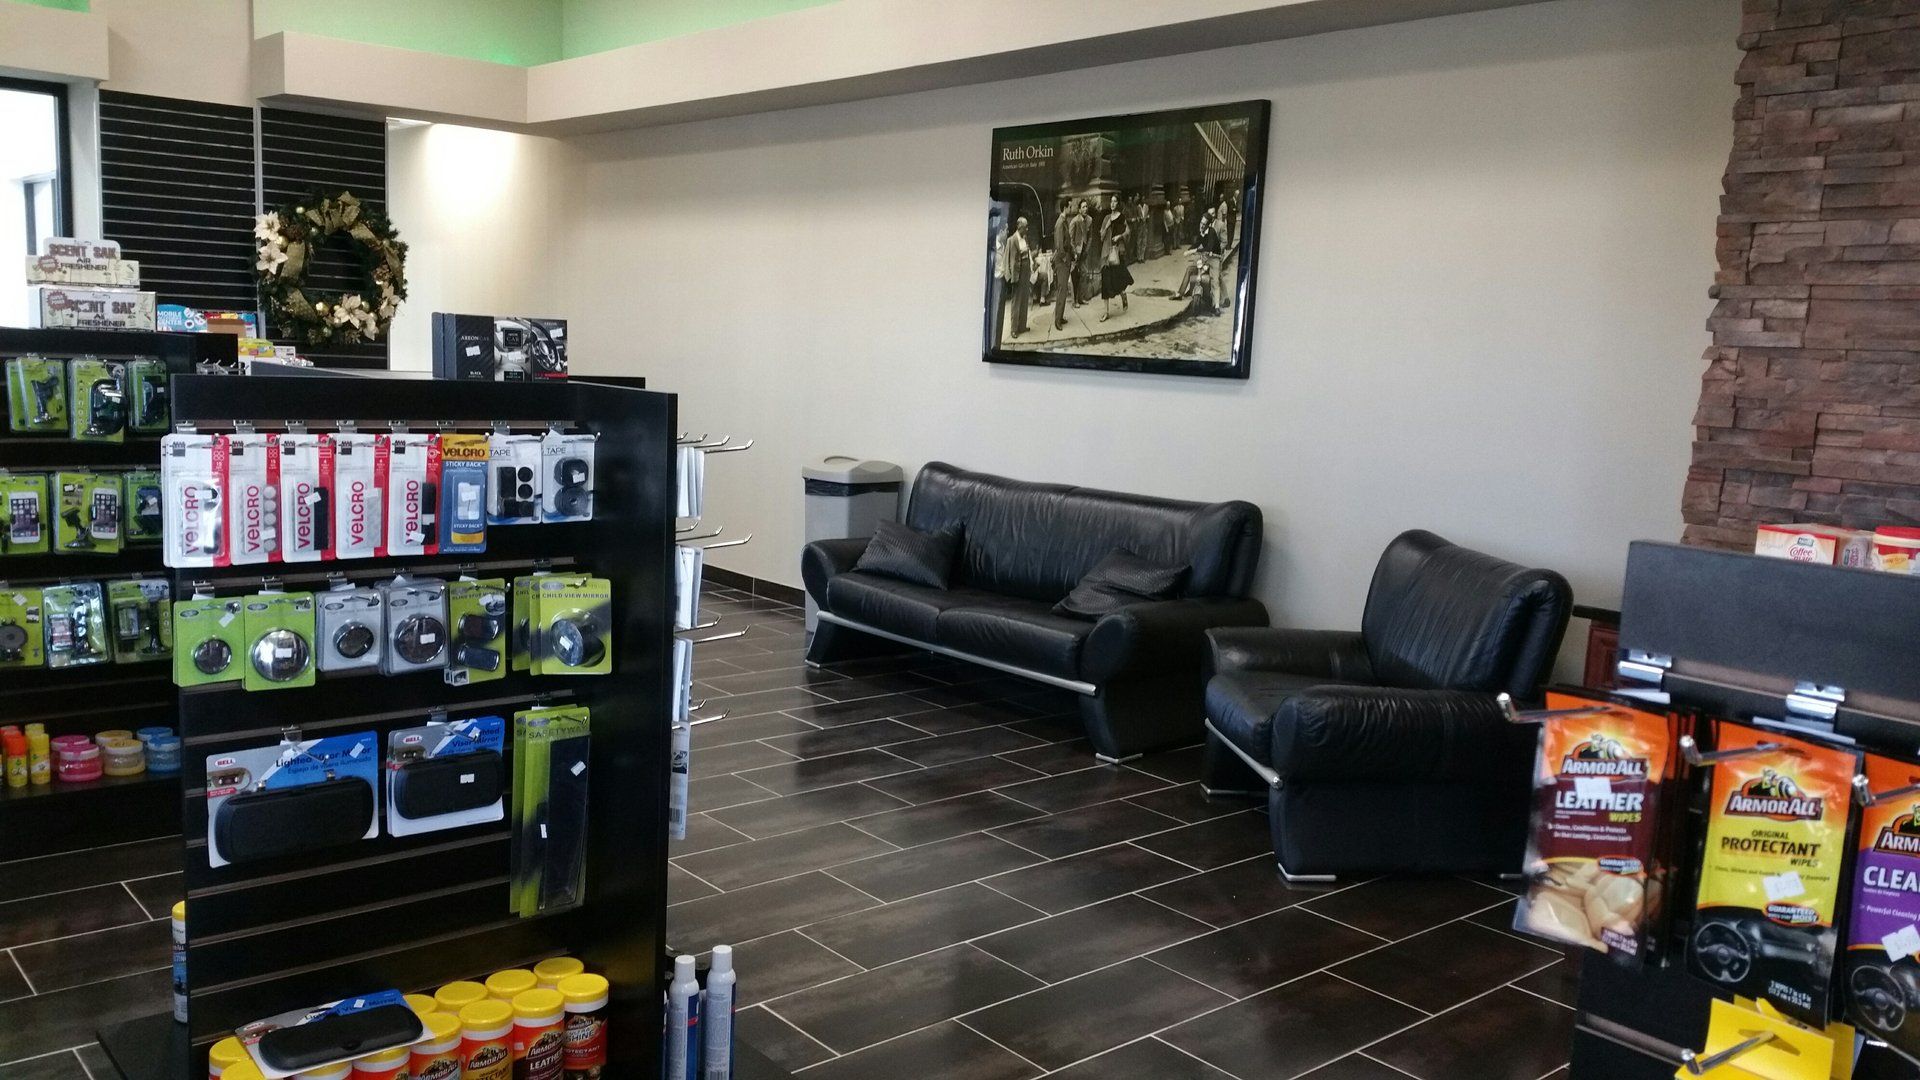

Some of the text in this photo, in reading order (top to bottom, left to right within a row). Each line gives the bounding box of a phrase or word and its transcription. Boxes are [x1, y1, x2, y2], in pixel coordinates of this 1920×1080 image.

[1003, 144, 1053, 160] Ruth Orkin
[49, 244, 87, 257] SCENT
[1789, 544, 1813, 557] Coffee
[1555, 790, 1644, 811] LEATHER
[1609, 812, 1641, 822] WIPES
[1752, 829, 1789, 839] ORIGINAL
[1881, 831, 1920, 853] ARM
[1721, 836, 1821, 857] PROTECTANT
[1790, 858, 1819, 868] WIPES
[1867, 905, 1892, 915] Powerful
[1892, 908, 1917, 921] Cleaning
[530, 1051, 562, 1070] LEATHE
